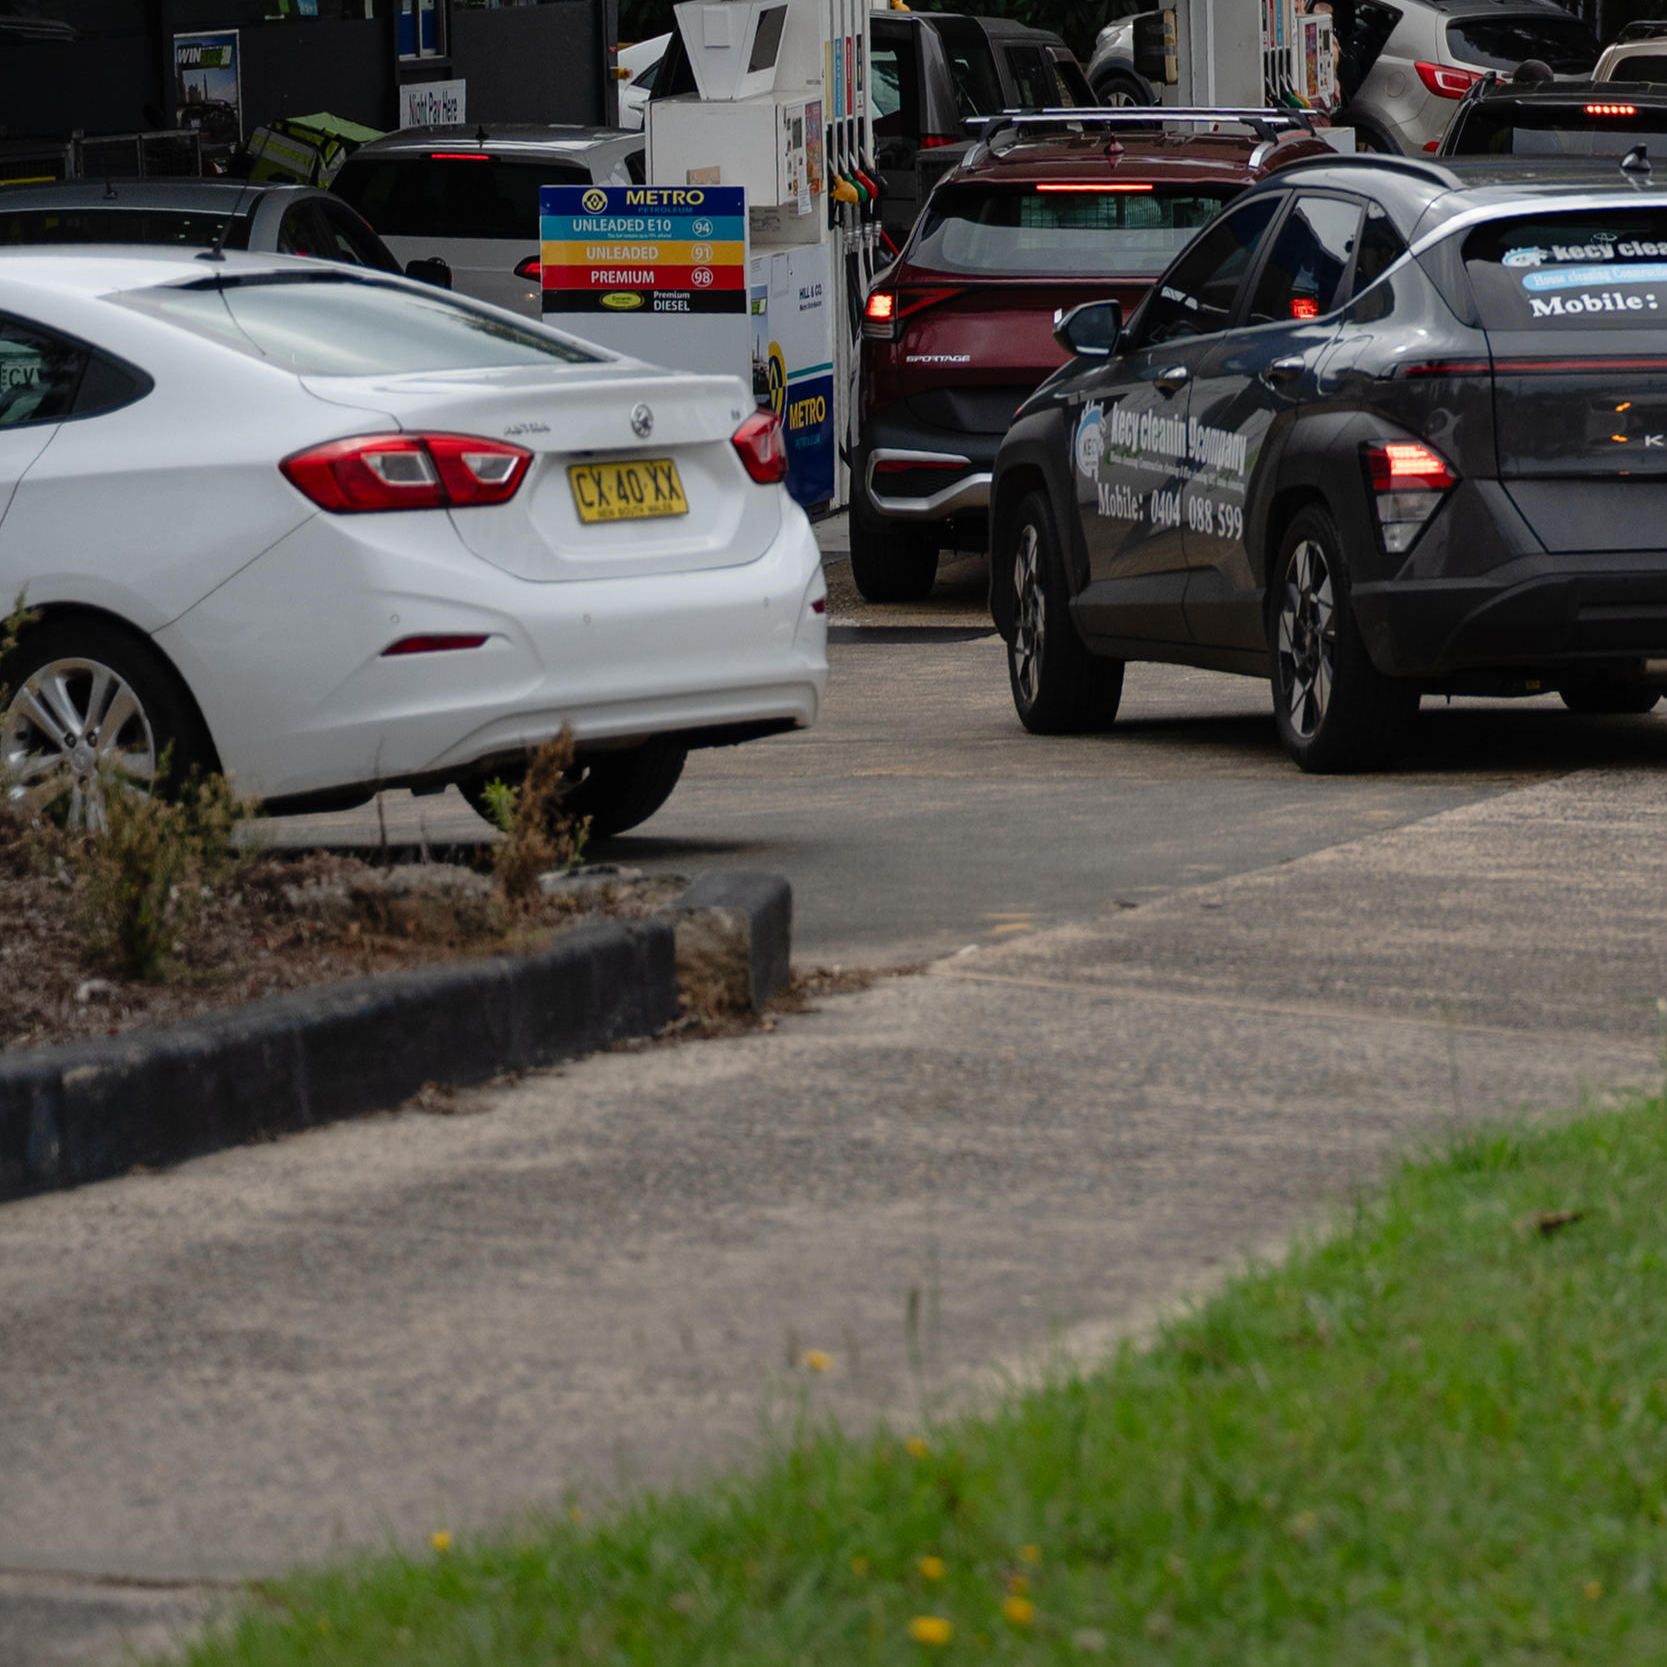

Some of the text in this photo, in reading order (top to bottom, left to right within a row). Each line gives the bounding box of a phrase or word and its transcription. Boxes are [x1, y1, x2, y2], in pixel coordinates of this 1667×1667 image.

[408, 91, 458, 126] Night Pay Here
[625, 189, 705, 205] METRO
[572, 219, 711, 233] UNLEADED E10 94
[586, 246, 710, 260] UNLEADED 91
[1552, 242, 1615, 263] kecy
[591, 270, 711, 284] PREMIUM 98
[653, 290, 691, 300] Premium
[653, 299, 690, 312] DIESEL
[1529, 293, 1658, 319] Mobile:
[789, 395, 826, 430] METRO
[1110, 400, 1140, 453] kecy
[1097, 482, 1244, 541] Mobile: 0404 088 599
